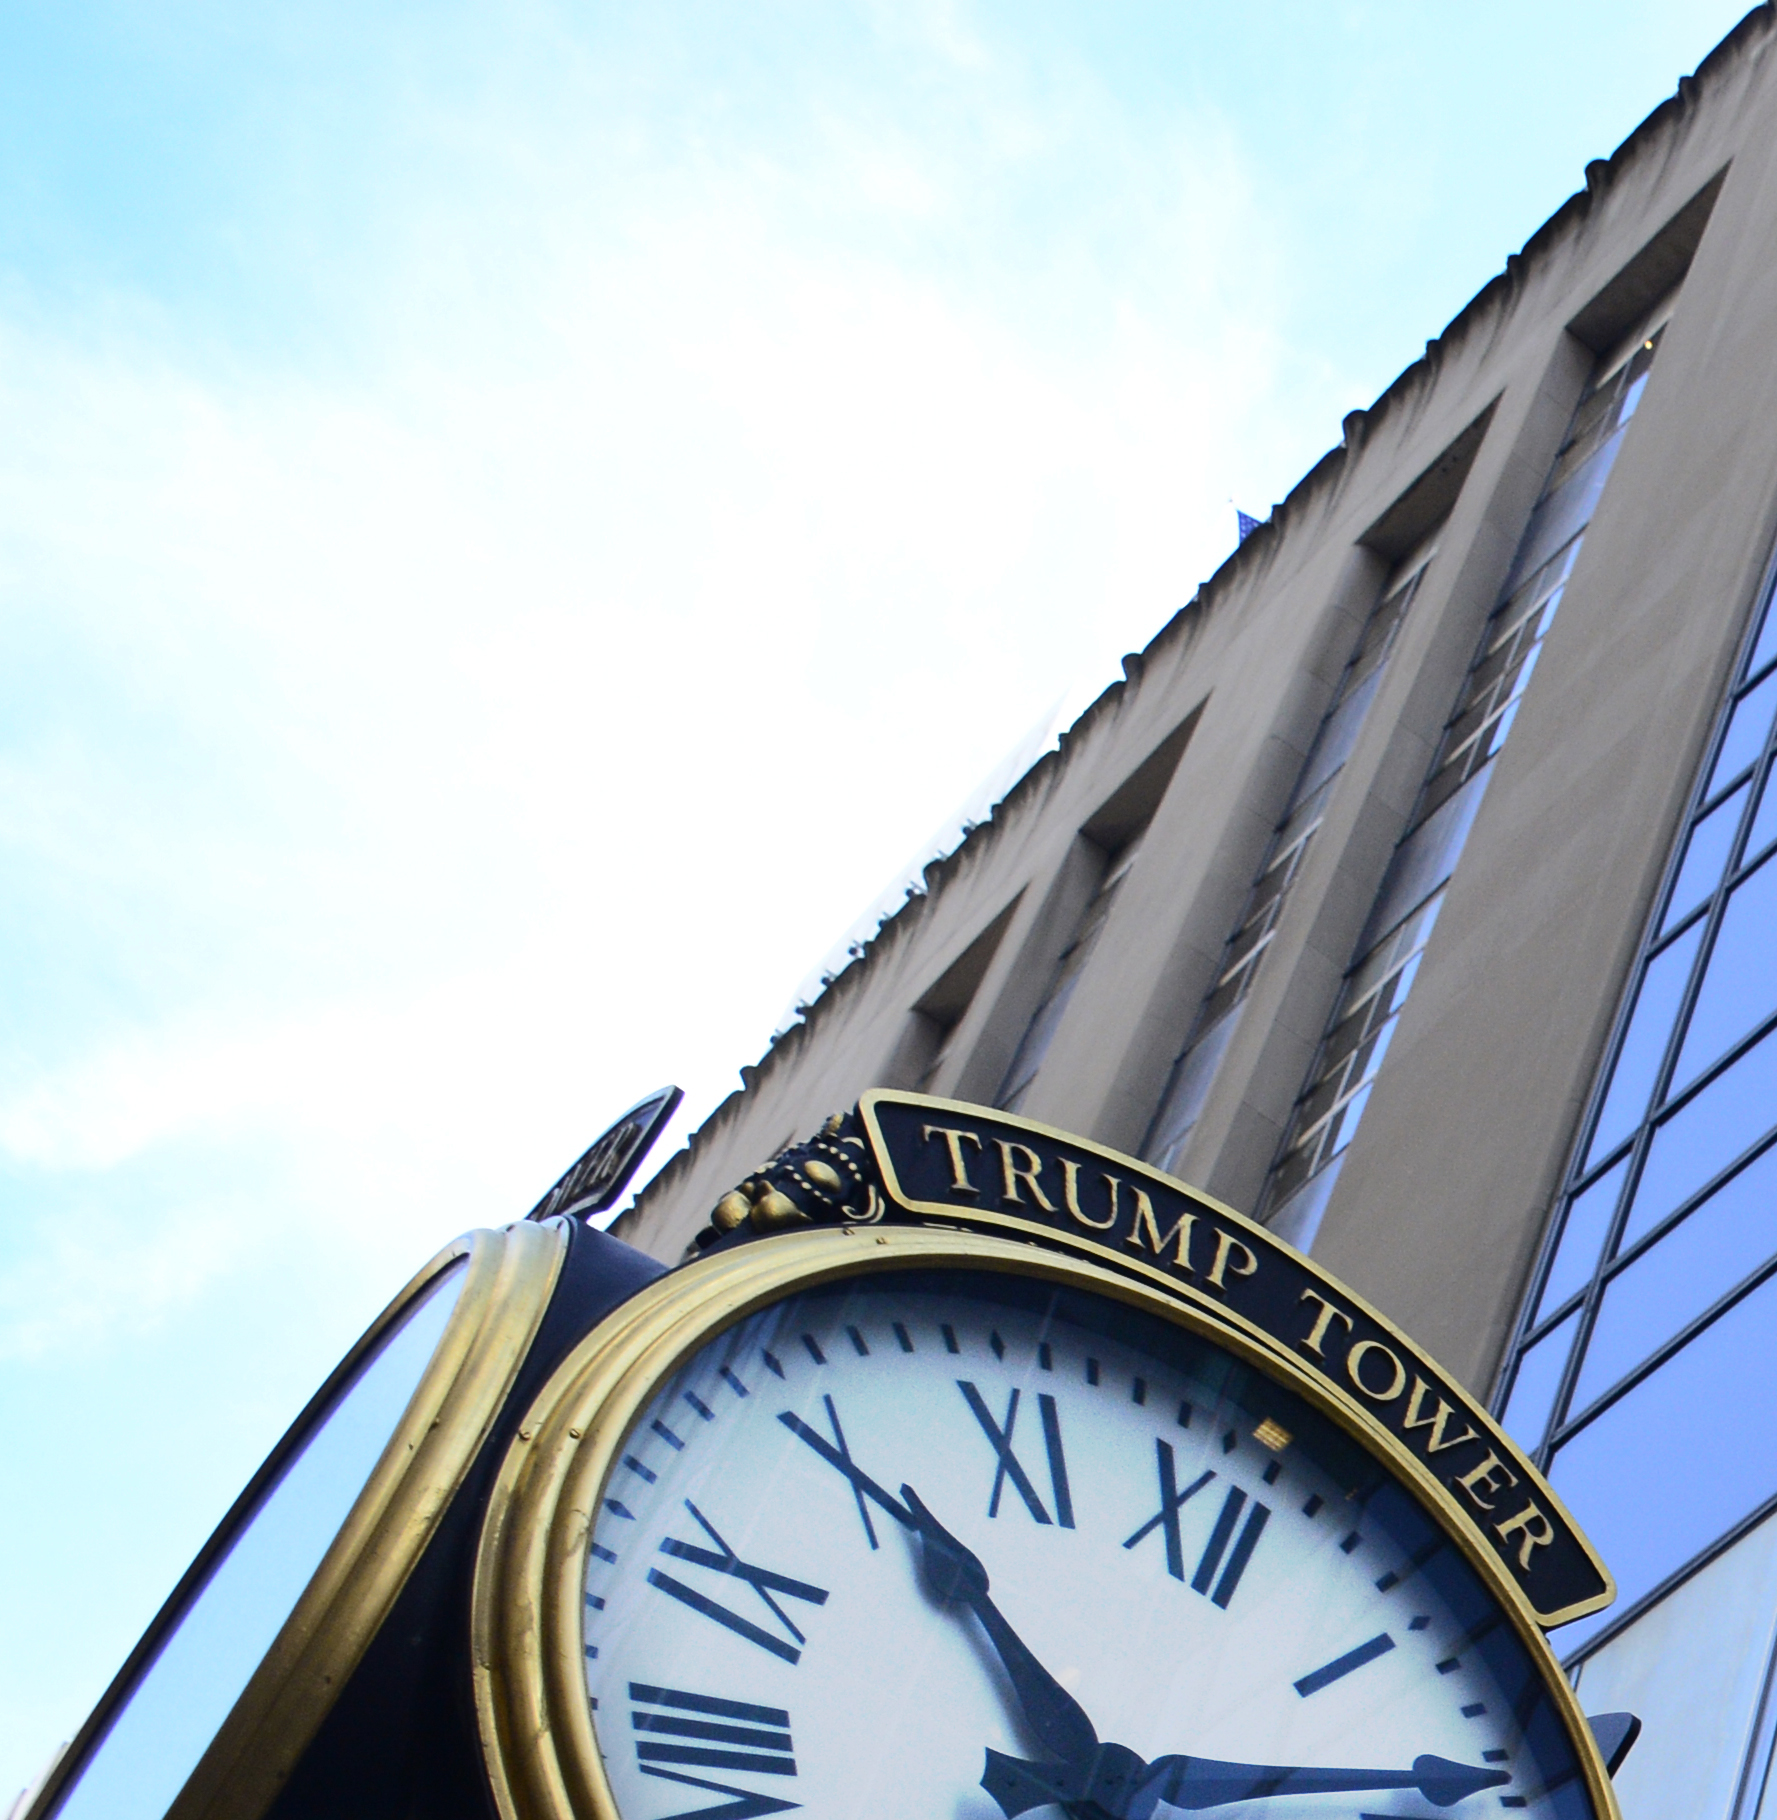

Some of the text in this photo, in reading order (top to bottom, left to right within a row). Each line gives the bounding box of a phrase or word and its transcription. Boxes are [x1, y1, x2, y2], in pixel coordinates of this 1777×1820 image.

[923, 1124, 1555, 1572] TRUMP TOWER
[776, 1393, 920, 1552] X
[956, 1379, 1076, 1529] XI
[1122, 1436, 1273, 1611] XII
[646, 1498, 830, 1666] IX
[1293, 1632, 1397, 1698] I
